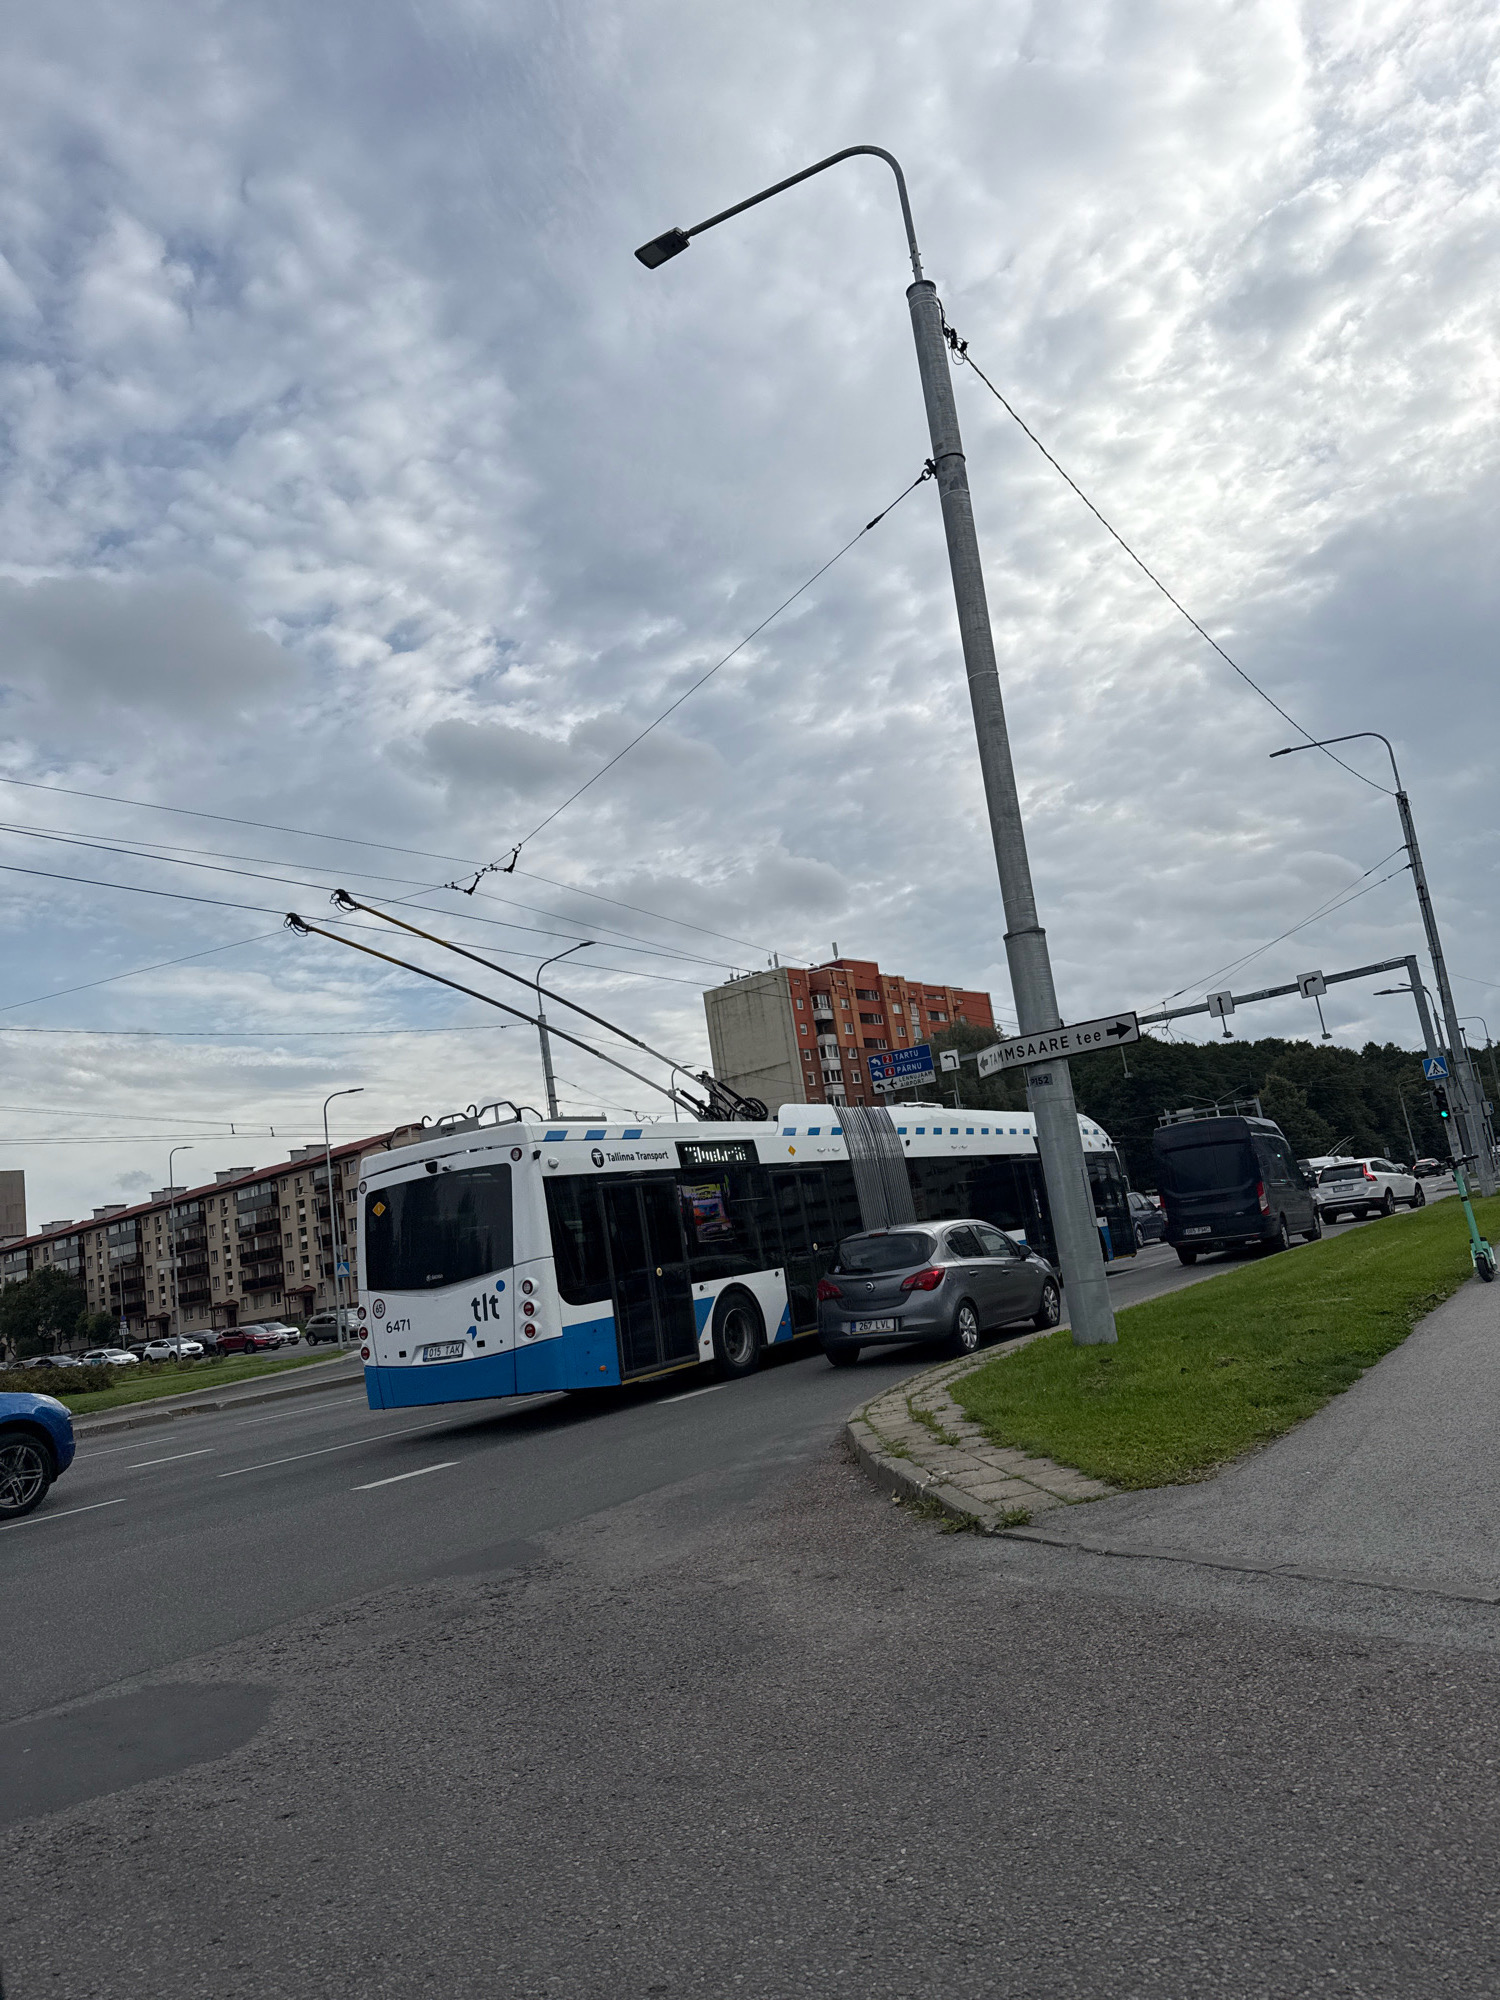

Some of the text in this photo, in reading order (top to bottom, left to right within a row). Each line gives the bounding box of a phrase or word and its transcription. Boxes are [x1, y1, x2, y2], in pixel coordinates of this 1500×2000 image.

[989, 1032, 1102, 1063] TAMMSAARE tee
[894, 1049, 919, 1061] TARTU
[896, 1062, 922, 1074] PÄRNU
[898, 1071, 933, 1083] LENNUJAAM
[900, 1078, 925, 1088] AIRPORT
[606, 1151, 669, 1162] Tallinna Transport
[375, 1304, 383, 1314] 65
[470, 1292, 500, 1322] tlt
[386, 1318, 411, 1334] 6471
[859, 1320, 890, 1331] 267 LVL
[429, 1344, 461, 1358] 015 TAK
